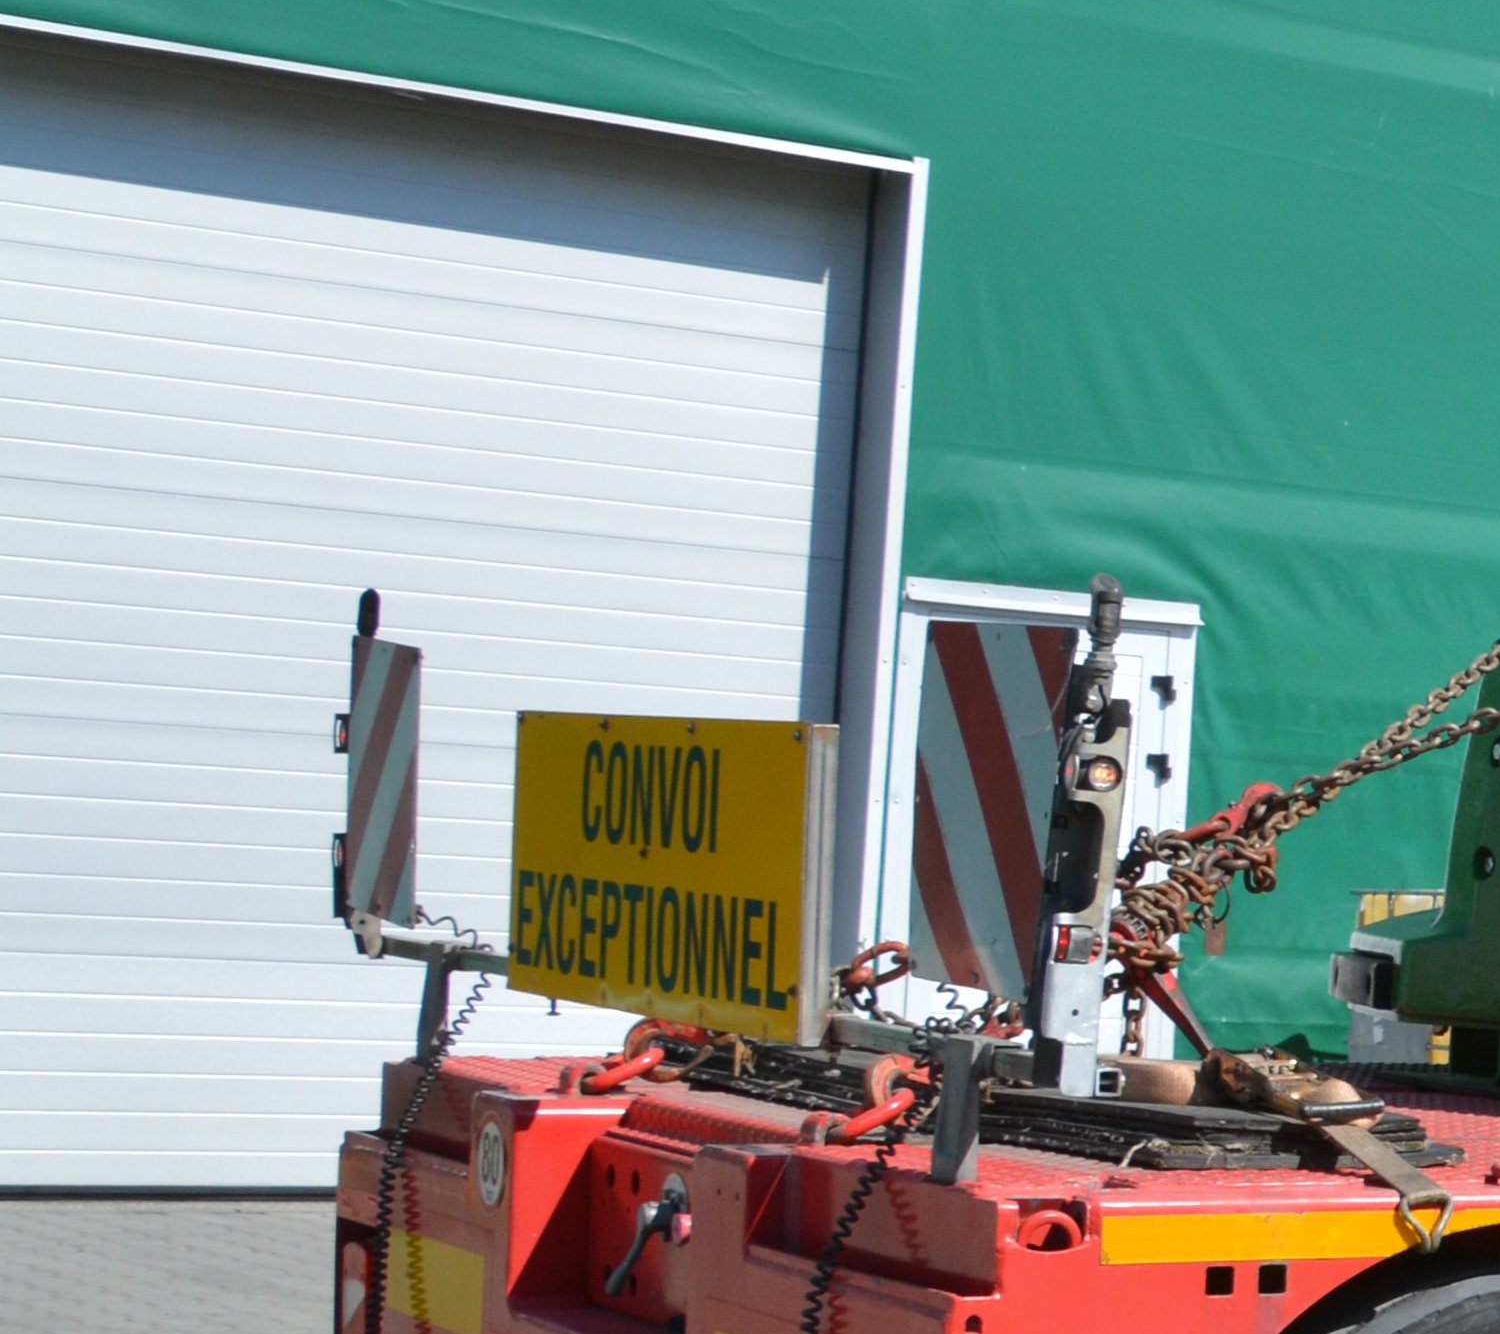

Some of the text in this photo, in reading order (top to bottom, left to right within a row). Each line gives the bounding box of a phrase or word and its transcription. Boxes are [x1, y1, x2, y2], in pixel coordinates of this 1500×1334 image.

[581, 740, 721, 855] CONVOI
[516, 868, 789, 1011] EXCEPTIONNEL
[482, 1132, 500, 1186] 80
